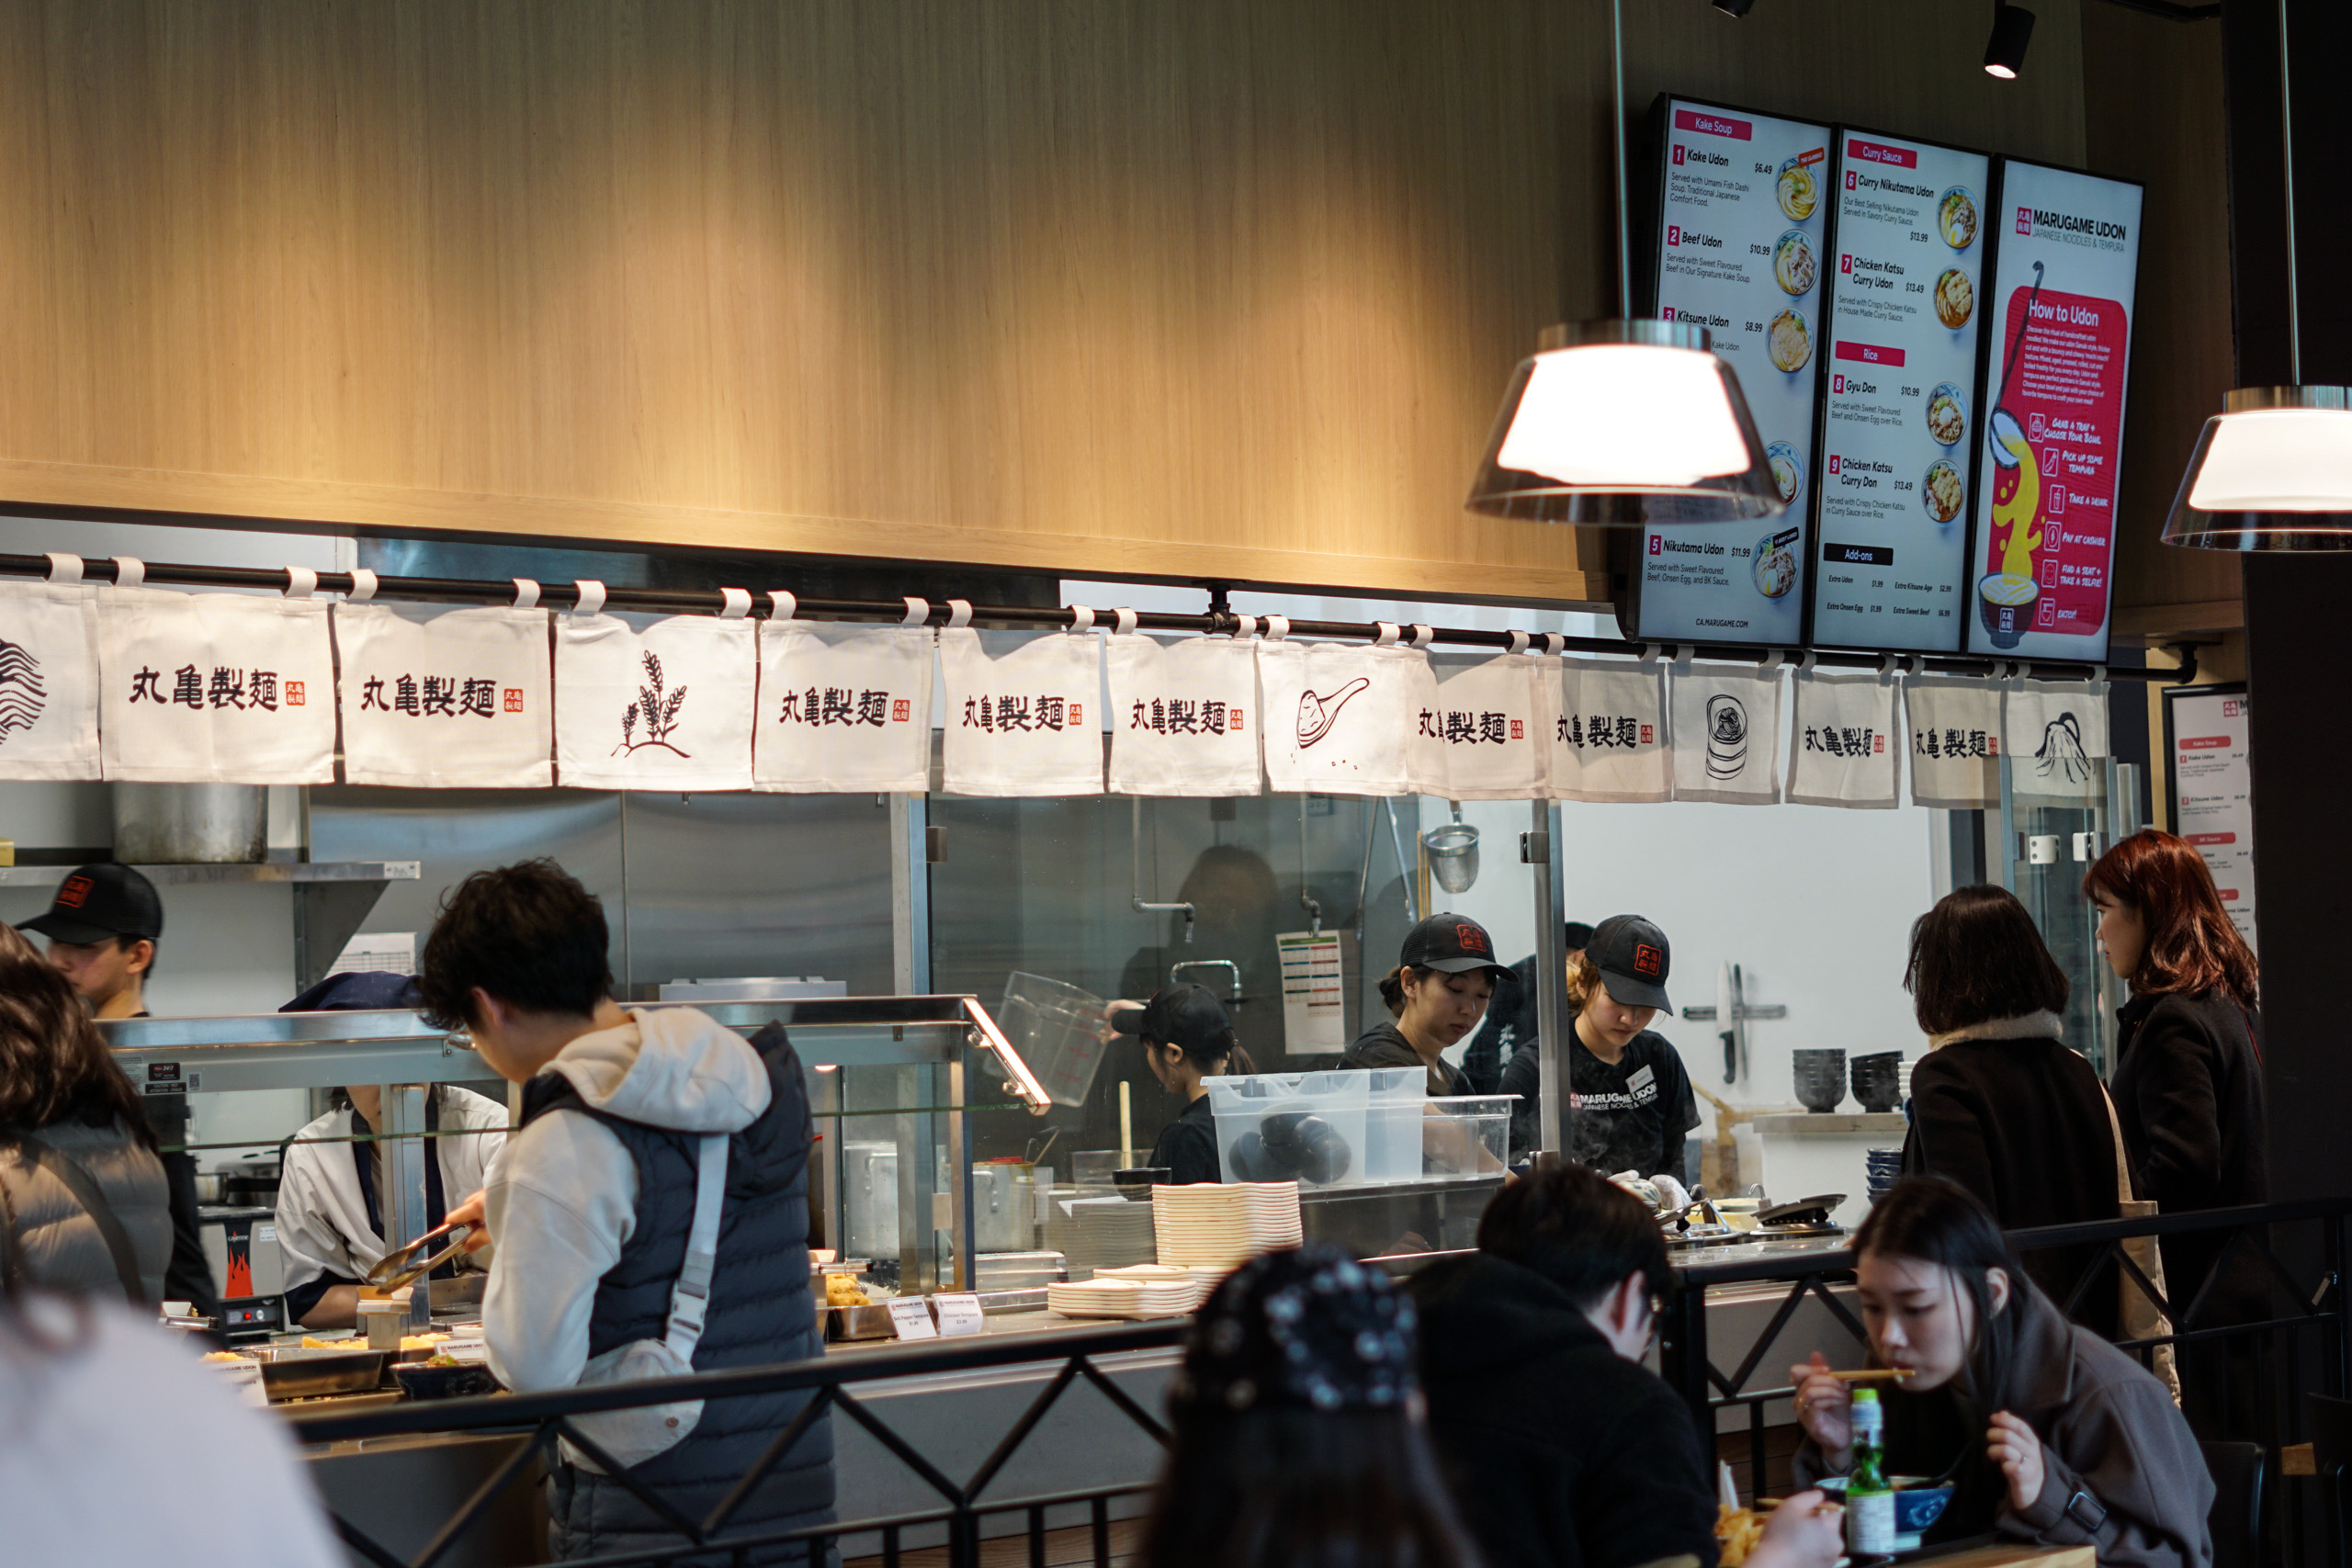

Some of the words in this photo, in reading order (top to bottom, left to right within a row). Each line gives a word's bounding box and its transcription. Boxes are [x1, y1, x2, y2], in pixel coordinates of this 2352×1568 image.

[1695, 117, 1713, 131] Kake
[1713, 120, 1733, 137] Soup
[1676, 148, 1682, 162] 1
[1686, 149, 1707, 163] Kake
[1708, 152, 1729, 167] Udon
[1754, 162, 1773, 175] $6.49
[1862, 146, 1882, 162] Curry
[1882, 149, 1903, 164] Sauce
[1671, 171, 1691, 183] Served
[1691, 176, 1703, 185] with
[1704, 177, 1723, 188] Umami
[1723, 180, 1734, 190] Fish
[1735, 182, 1749, 192] Dashi
[1847, 174, 1855, 187] 6
[1858, 174, 1879, 191] Curry
[1879, 178, 1915, 195] Nikutama
[1916, 185, 1934, 198] Udon
[1669, 192, 1693, 205] Comfort
[1693, 196, 1709, 207] Food.
[1670, 182, 1686, 194] Soup.
[1687, 184, 1715, 197] Traditional
[1715, 191, 1740, 202] Japanese
[2033, 209, 2095, 235] MARUGAME
[2095, 221, 2126, 241] UDON
[1670, 229, 1678, 243] 2
[1681, 231, 1701, 245] Beef
[1701, 234, 1723, 248] Udon
[1749, 243, 1771, 256] $10.99
[1910, 231, 1928, 243] $13.99
[2032, 228, 2062, 242] JAPANESE
[2062, 233, 2092, 247] NOODLES
[2092, 238, 2098, 248] &
[2098, 239, 2125, 253] TEMPURA
[1666, 252, 1686, 264] Served
[1686, 257, 1699, 265] with
[1699, 257, 1716, 268] Sweet
[1716, 259, 1743, 272] Flavoured
[1843, 257, 1851, 270] 7
[1853, 257, 1883, 272] Chicken
[1883, 261, 1904, 275] Katsu
[1665, 263, 1679, 273] Beef
[1685, 265, 1696, 275] Our
[1696, 267, 1722, 279] Signature
[1723, 271, 1736, 281] Kake
[1736, 273, 1751, 284] Soup.
[1852, 273, 1874, 289] Curry
[1874, 276, 1894, 289] Udon
[1905, 282, 1925, 294] $13.49
[1838, 294, 1856, 305] Served
[1867, 299, 1883, 311] Crispy
[1883, 301, 1903, 312] Chicken
[1903, 305, 1917, 314] Katsu
[1843, 305, 1859, 316] House
[1859, 308, 1873, 318] Made
[1873, 310, 1887, 321] Curry
[1888, 312, 1904, 322] Sauce.
[2028, 298, 2055, 320] How
[2056, 304, 2068, 322] to
[2070, 305, 2099, 327] Udon
[1677, 310, 1708, 325] Kitsune
[1709, 314, 1729, 328] Udon
[1745, 321, 1763, 333] $8.99
[1863, 348, 1878, 361] Rice
[1835, 377, 1842, 391] 8
[1846, 379, 1861, 394] Gyu
[1862, 381, 1877, 394] Don
[1900, 385, 1920, 397] $10.99
[1831, 400, 1850, 411] Served
[1849, 403, 1861, 412] with
[1861, 403, 1877, 413] Sweet
[1877, 405, 1901, 416] Flavoured
[1831, 410, 1843, 420] Beef
[1843, 413, 1854, 421] and
[1853, 412, 1870, 422] Onsen
[1870, 414, 1880, 426] Egg
[1891, 417, 1903, 426] Rice.
[1831, 458, 1838, 472] 9
[1841, 457, 1871, 471] Chicken
[1872, 461, 1893, 474] Katsu
[1841, 473, 1862, 489] Curry
[1862, 476, 1878, 488] Don
[1894, 480, 1913, 491] $13.49
[1652, 538, 1659, 552] 5
[1663, 539, 1703, 554] Nikutama
[1704, 543, 1725, 555] Udon
[1731, 546, 1751, 558] $11.99
[1844, 548, 1873, 562] Add-ons
[1647, 561, 1667, 572] Served
[1667, 564, 1680, 572] with
[1680, 563, 1698, 573] Sweet
[1698, 565, 1724, 575] Flavoured
[1646, 572, 1661, 583] Beef,
[1661, 573, 1680, 583] Onsen
[1680, 574, 1692, 586] Egg,
[1703, 575, 1712, 585] BK
[1712, 576, 1730, 586] Sauce.
[1695, 618, 1749, 628] CA.MARUGAME.COM
[1580, 1093, 1633, 1104] MARUGME
[1632, 1083, 1657, 1101] UDON
[228, 1234, 249, 1242] cayenne
